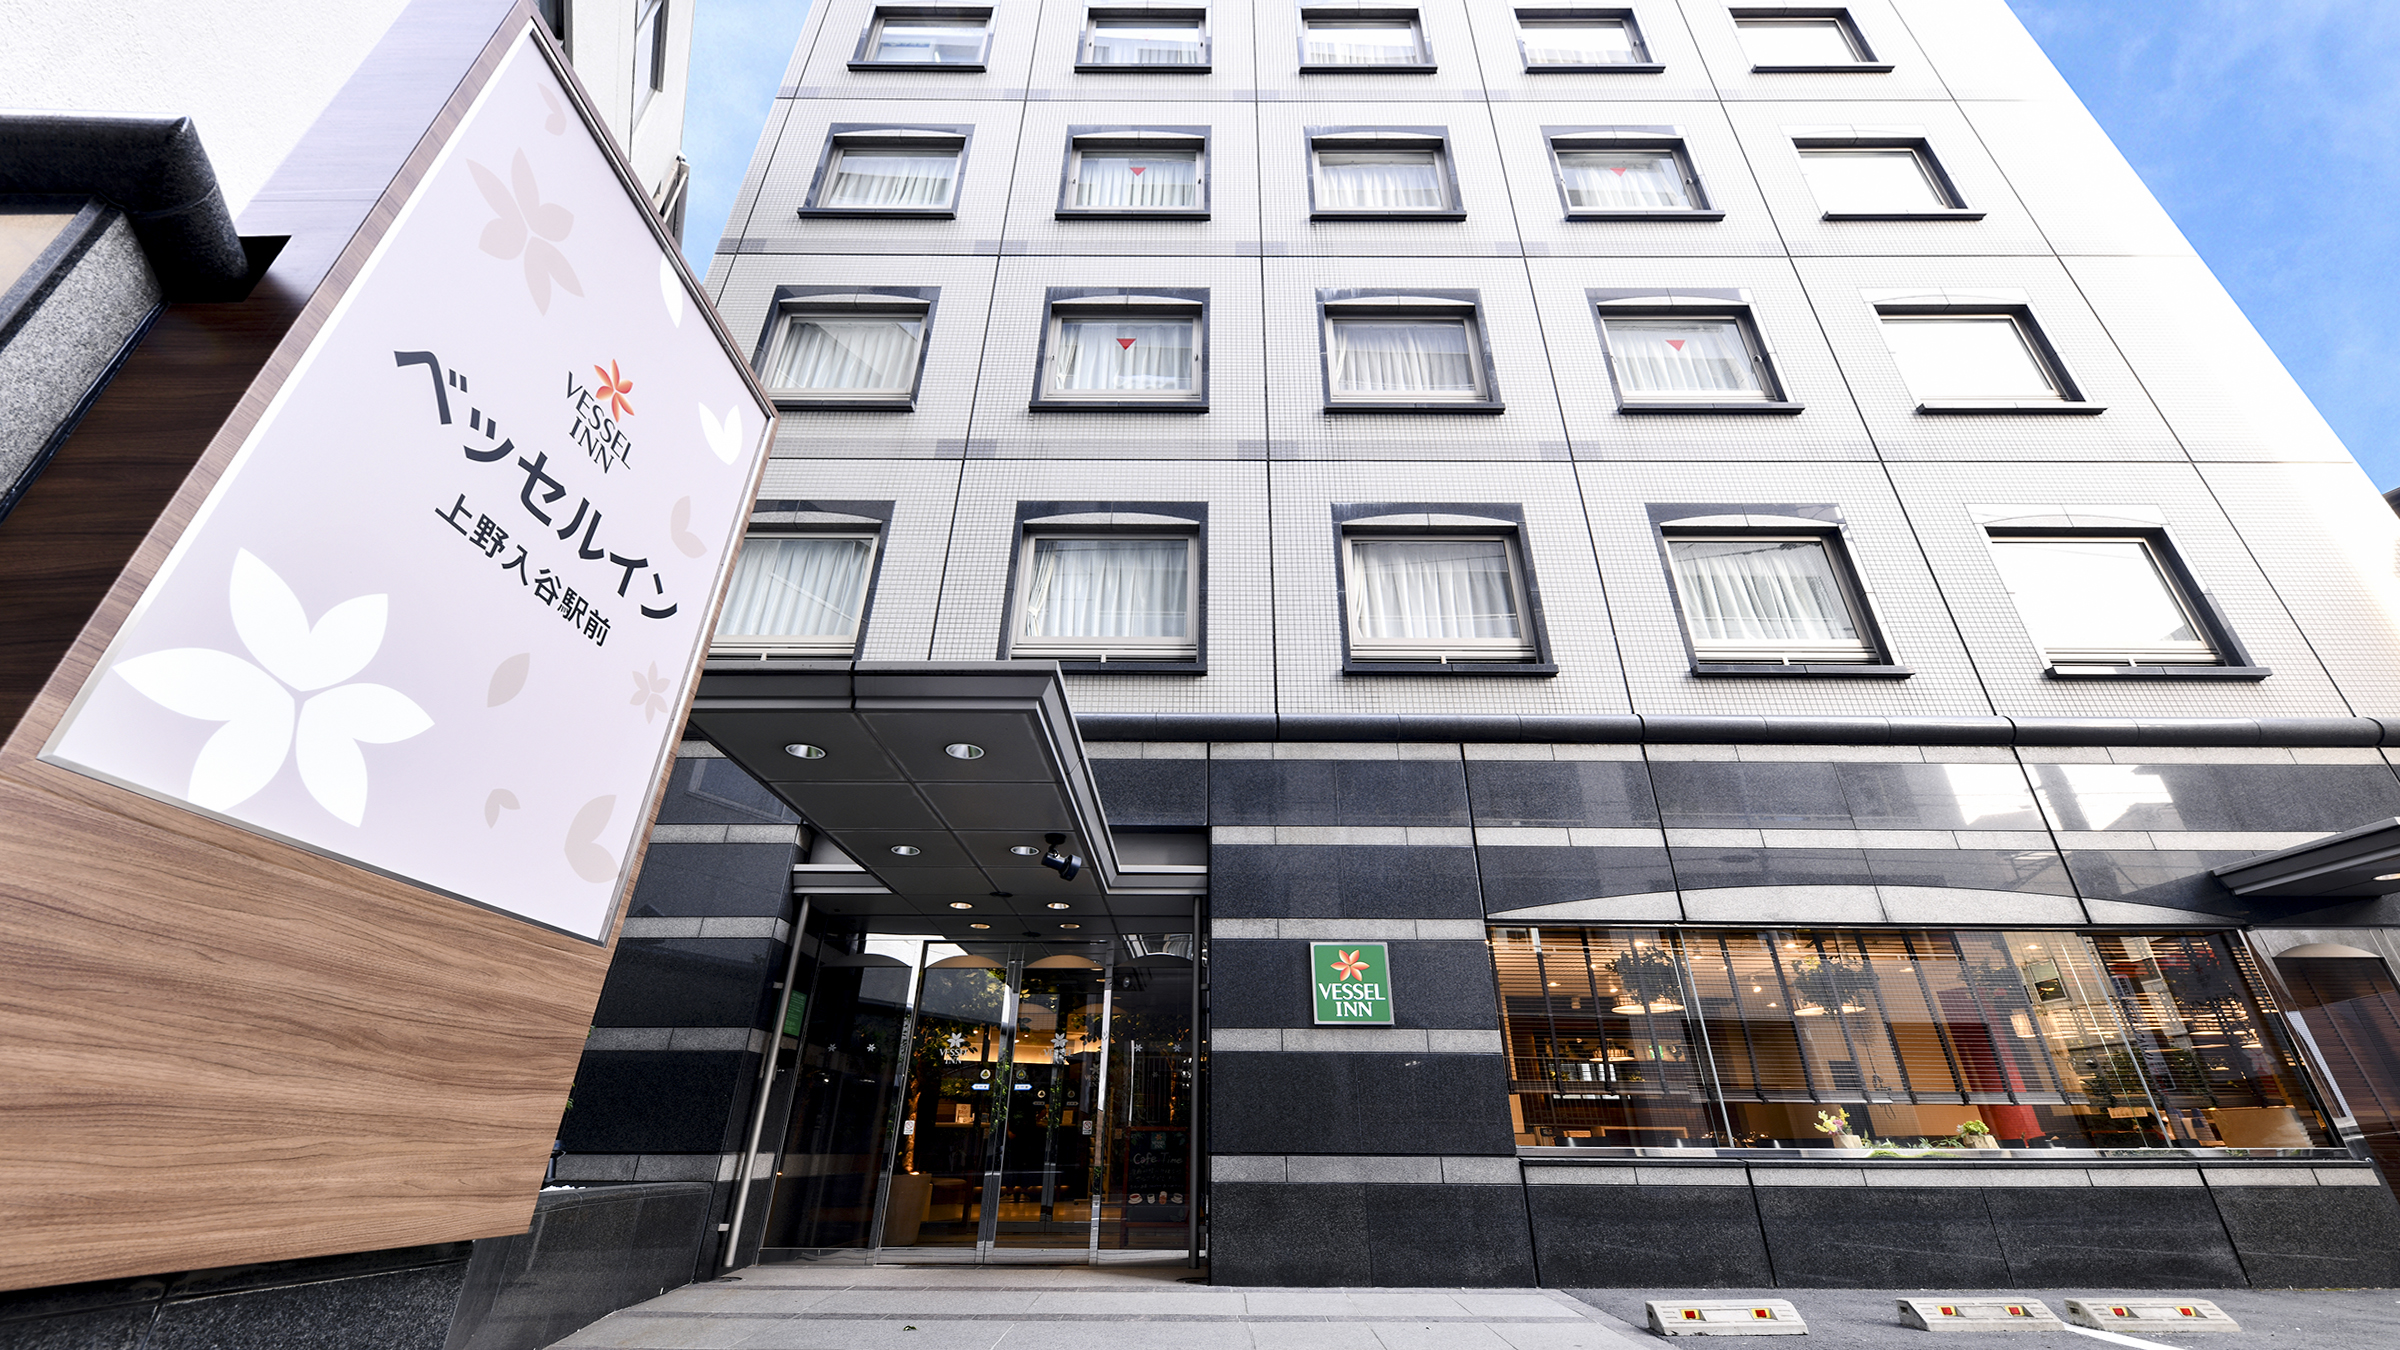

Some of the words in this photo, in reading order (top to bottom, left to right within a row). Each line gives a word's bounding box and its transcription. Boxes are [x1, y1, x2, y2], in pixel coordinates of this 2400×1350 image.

[566, 370, 631, 470] VESSEL
[568, 416, 614, 474] INN
[393, 350, 678, 619] ベッセルイン
[434, 493, 611, 647] 上野入谷駅前
[1318, 983, 1386, 1000] VESSEL
[1335, 1001, 1372, 1017] INN
